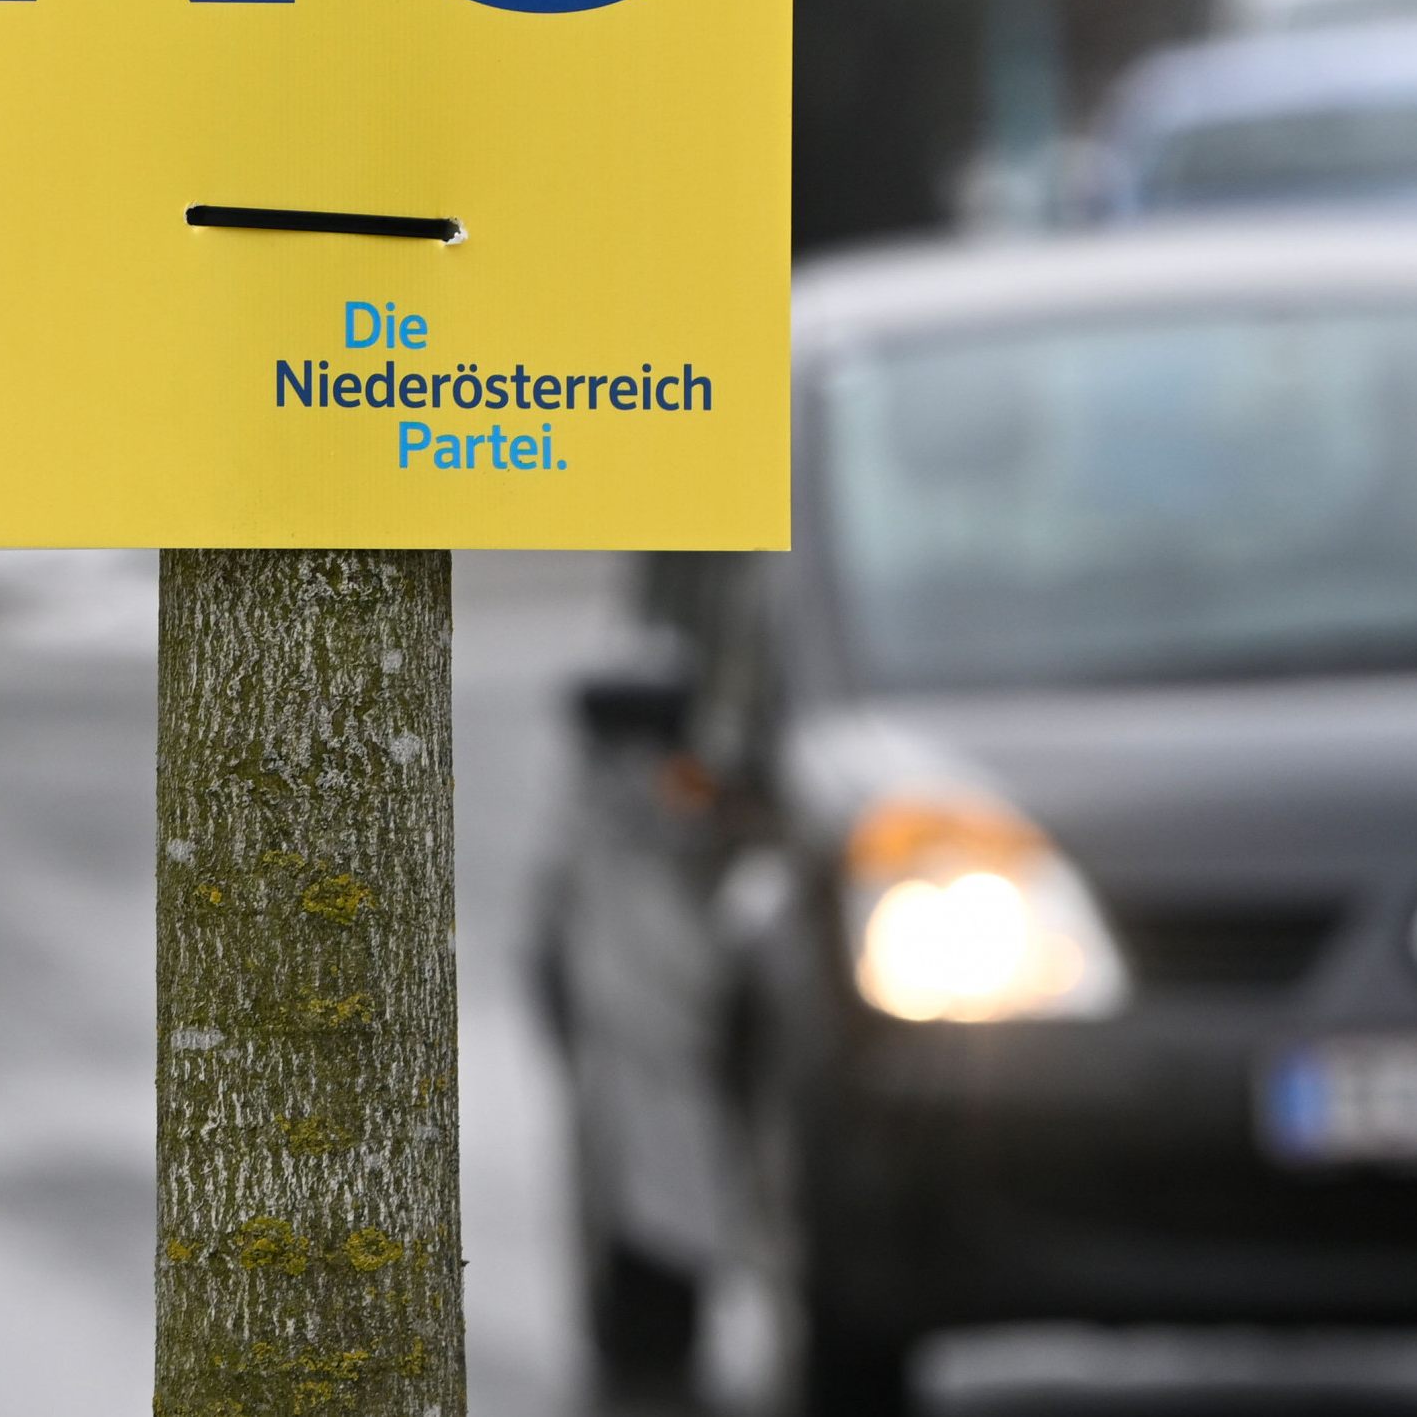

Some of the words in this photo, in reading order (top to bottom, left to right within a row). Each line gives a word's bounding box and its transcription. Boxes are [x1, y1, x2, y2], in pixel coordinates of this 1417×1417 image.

[344, 300, 429, 350] Die
[275, 359, 713, 412] Niederösterreich
[398, 421, 568, 471] Partei.
